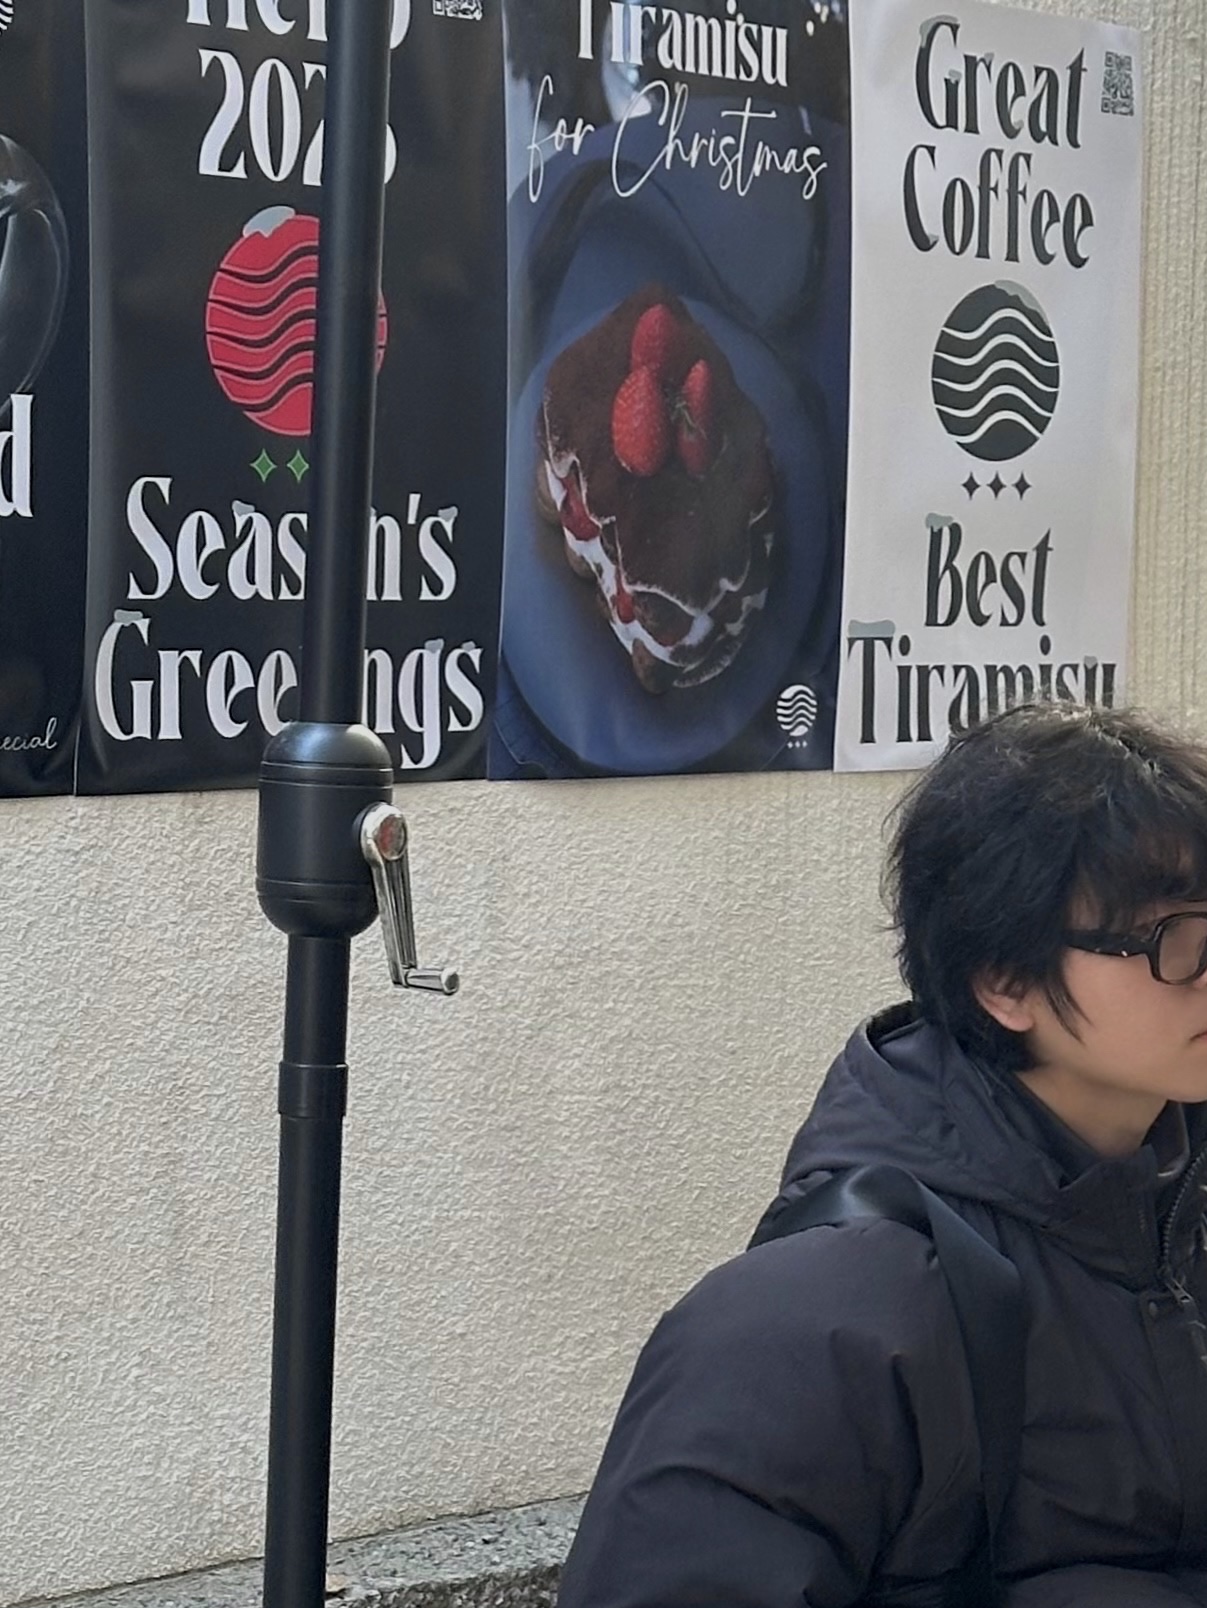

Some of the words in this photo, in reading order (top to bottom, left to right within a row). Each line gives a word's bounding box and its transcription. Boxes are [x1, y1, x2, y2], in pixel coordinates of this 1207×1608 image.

[527, 75, 595, 203] for
[612, 79, 828, 200] Christmas
[915, 16, 1087, 149] Great
[903, 144, 1094, 269] Coffee
[126, 476, 458, 600] Seasn's
[924, 517, 1054, 627] Best
[95, 611, 484, 769] Greengs
